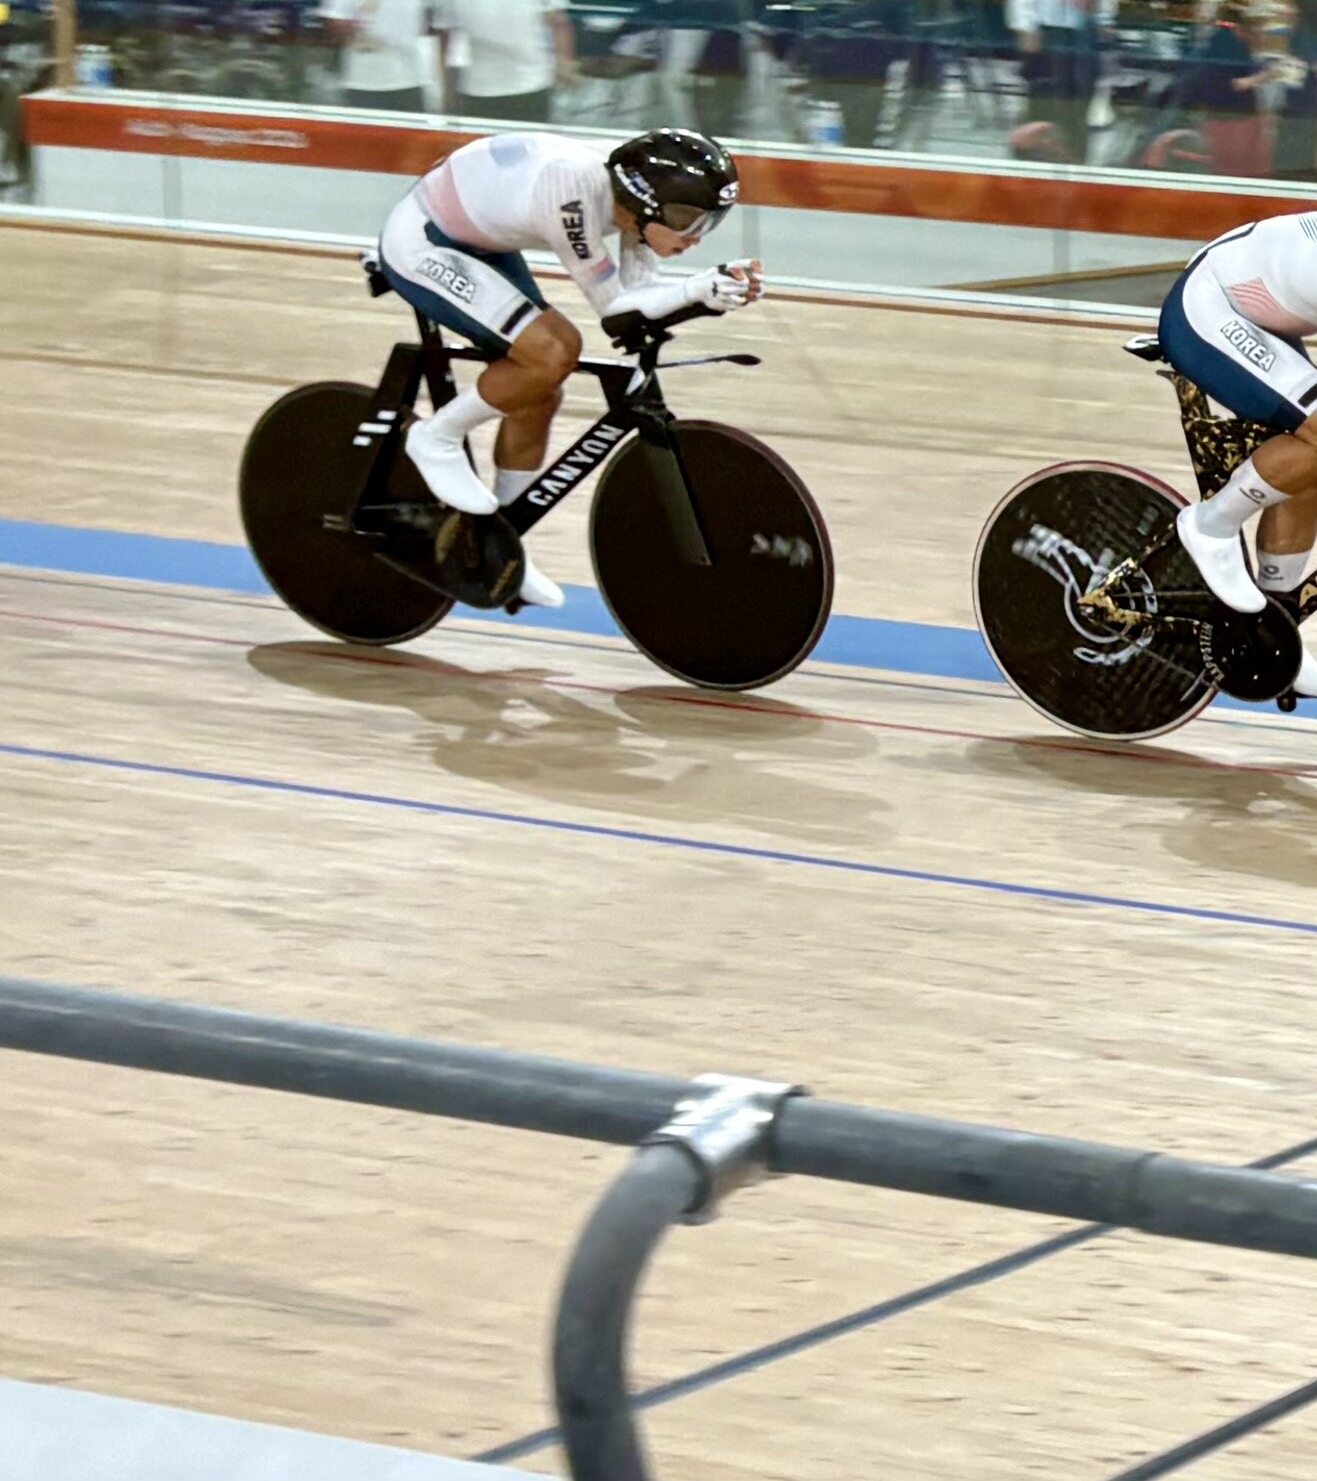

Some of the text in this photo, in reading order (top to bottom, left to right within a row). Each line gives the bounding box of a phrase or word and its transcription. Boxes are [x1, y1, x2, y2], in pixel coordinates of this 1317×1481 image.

[560, 199, 592, 260] KOREA
[414, 256, 476, 304] KOREA
[1219, 319, 1277, 373] KOREA
[526, 423, 625, 506] CANYON
